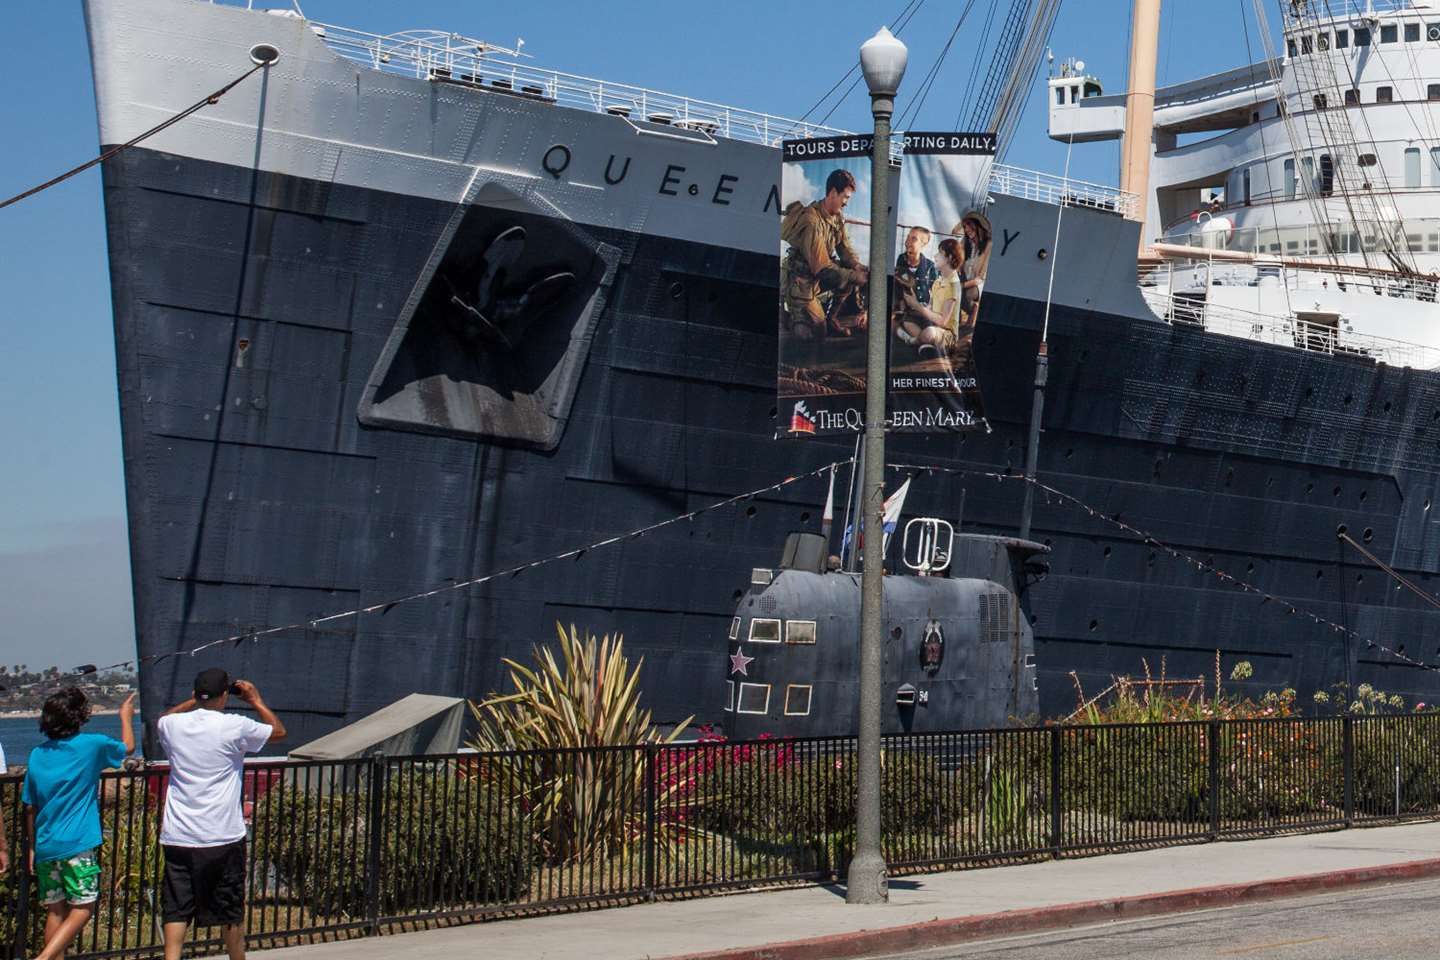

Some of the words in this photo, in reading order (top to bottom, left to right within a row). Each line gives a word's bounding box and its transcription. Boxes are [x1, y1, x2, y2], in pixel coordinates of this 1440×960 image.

[787, 141, 835, 156] TOURS
[893, 377, 912, 388] HER
[916, 377, 950, 388] FINEST
[817, 410, 845, 429] THE
